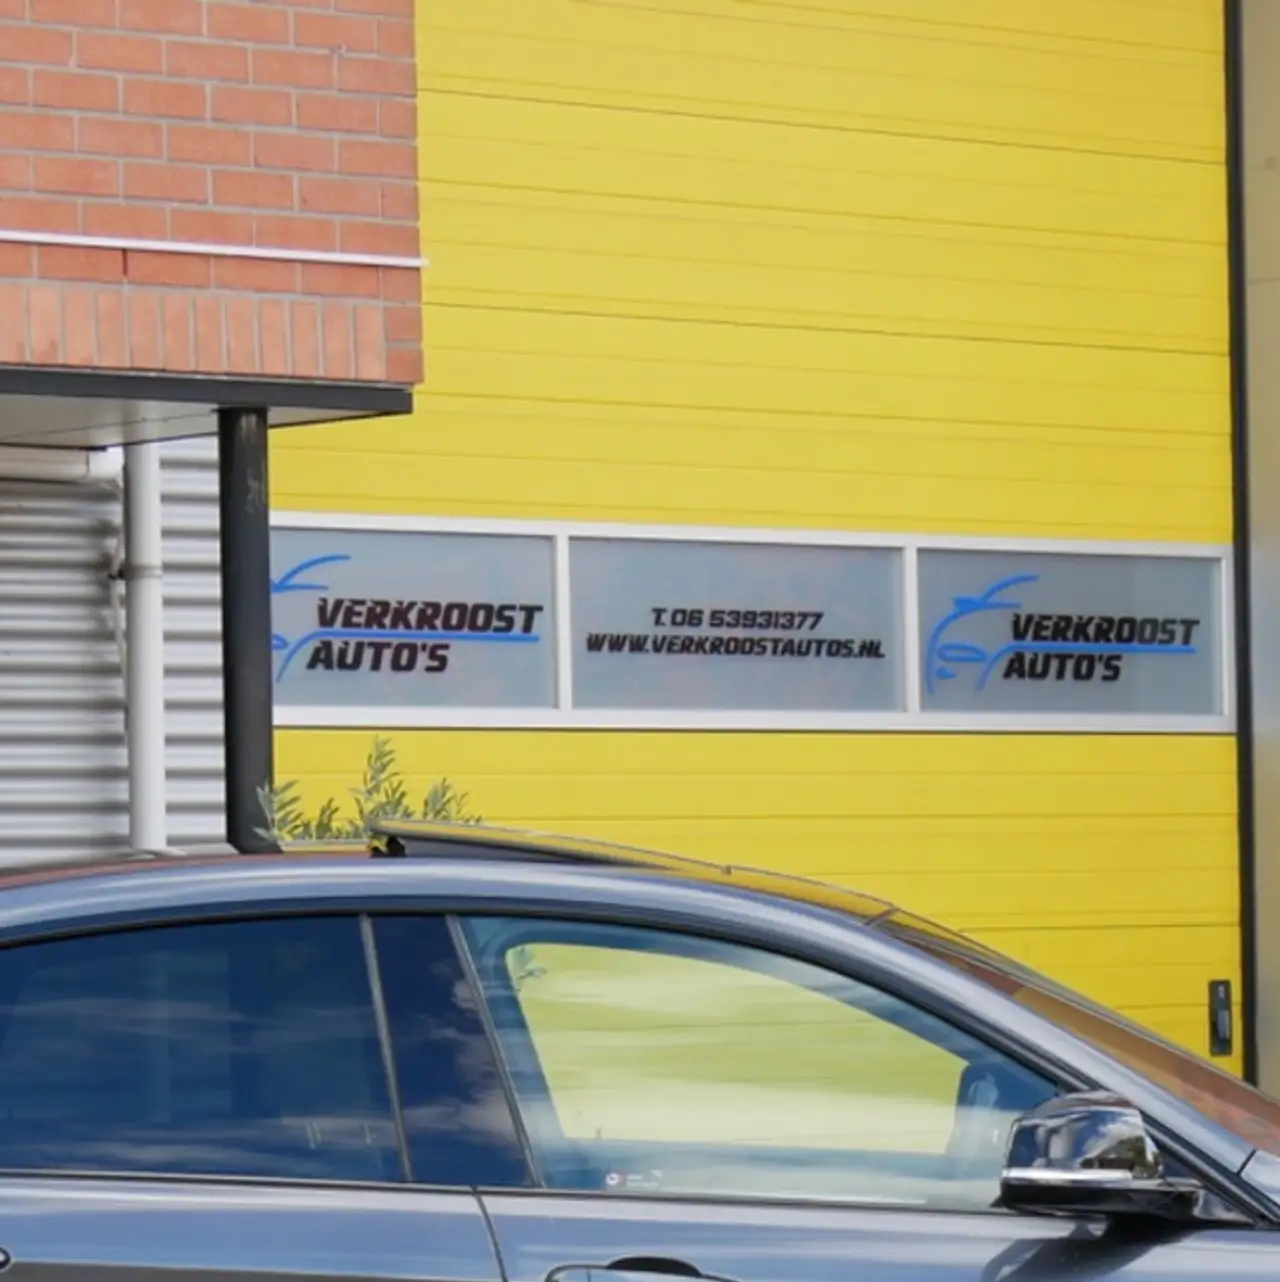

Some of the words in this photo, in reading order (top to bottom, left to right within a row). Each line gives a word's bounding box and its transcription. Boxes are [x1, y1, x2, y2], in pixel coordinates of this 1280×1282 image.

[317, 598, 543, 634] VERKROOST
[1010, 612, 1199, 646] VERKROOST
[305, 639, 450, 672] AUTO'S
[586, 632, 886, 659] WWW.VERKROOSTAUTOS.NL
[1003, 652, 1122, 682] AUTO'S
